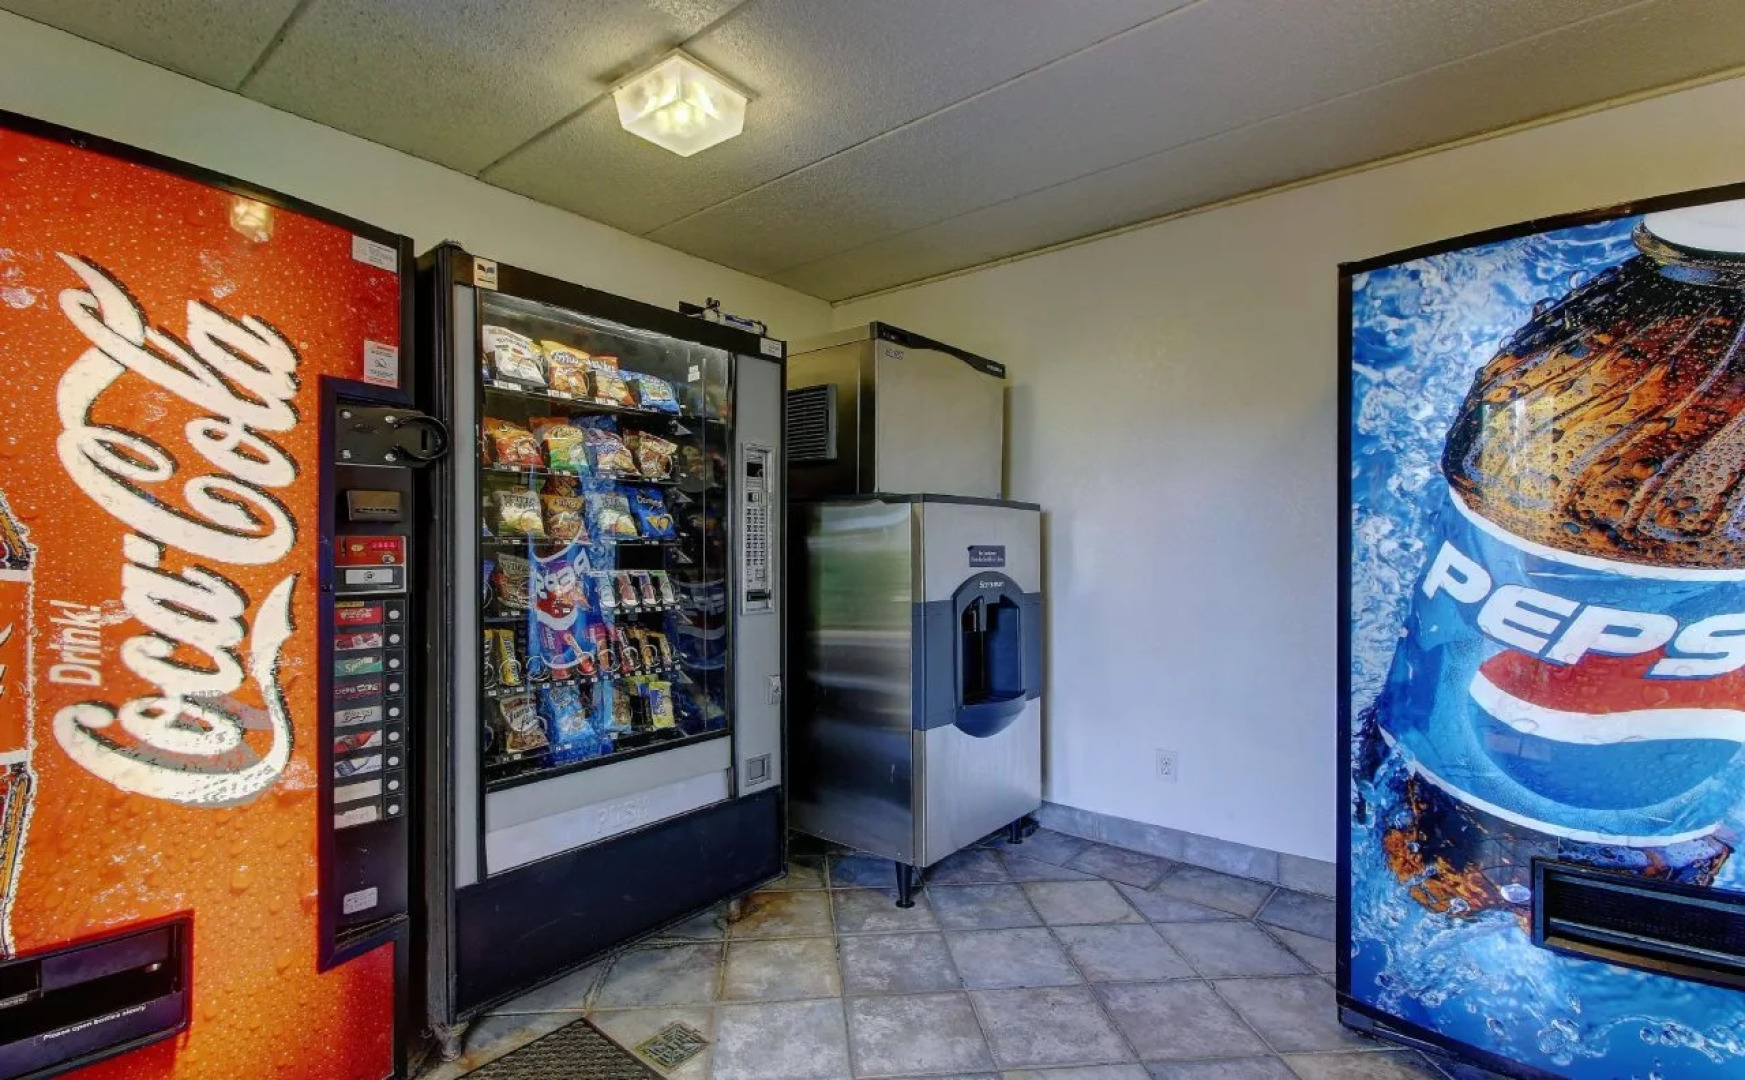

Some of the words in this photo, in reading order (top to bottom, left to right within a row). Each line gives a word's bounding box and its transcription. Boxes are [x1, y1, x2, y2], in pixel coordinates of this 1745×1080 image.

[52, 250, 300, 808] Coca-Cola
[49, 599, 102, 686] Drink!
[43, 1027, 70, 1041] Please
[72, 1021, 92, 1032] open
[122, 1003, 147, 1017] slowly
